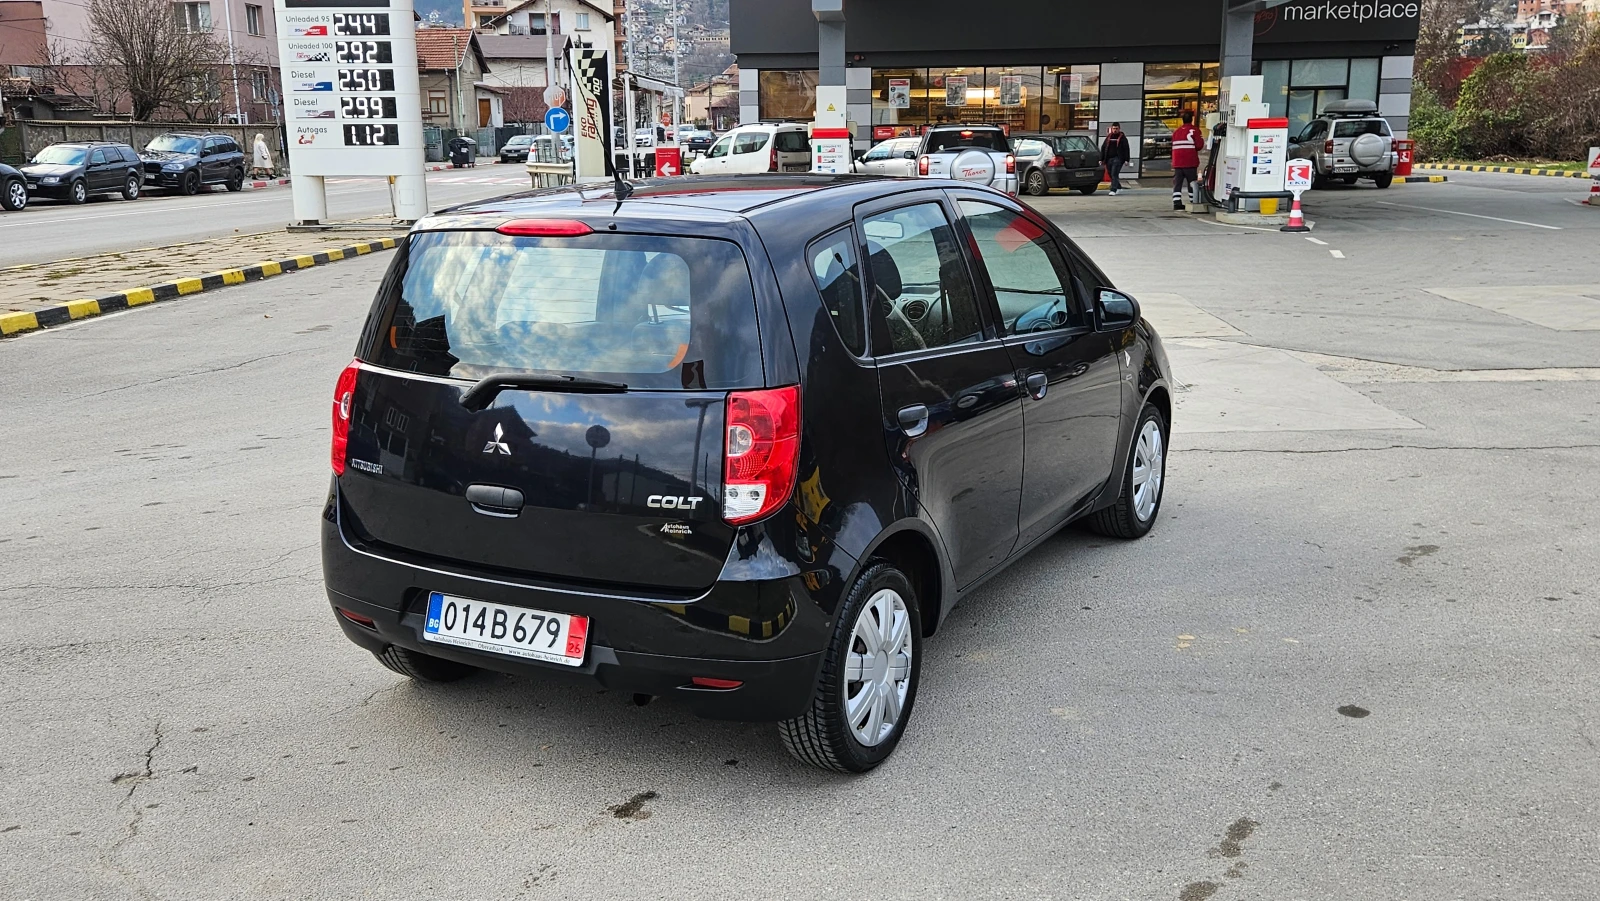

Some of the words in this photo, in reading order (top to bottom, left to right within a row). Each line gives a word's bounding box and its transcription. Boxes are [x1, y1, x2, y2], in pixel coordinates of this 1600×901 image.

[285, 15, 319, 23] Unleaded
[1284, 0, 1418, 23] marketplace
[334, 13, 376, 36] 2.44
[288, 42, 320, 50] Unleaded
[336, 41, 378, 63] 2.92
[291, 70, 316, 78] Diesel
[339, 69, 381, 91] 2.50
[592, 77, 601, 96] 100
[293, 98, 318, 106] Diesel
[342, 97, 383, 119] 2.99
[297, 126, 328, 135] Autogas
[351, 124, 385, 145] 1.12
[580, 117, 588, 138] EKO
[646, 494, 703, 510] COLT
[428, 618, 440, 628] BG
[444, 601, 561, 648] 014B679
[567, 642, 581, 654] 26
